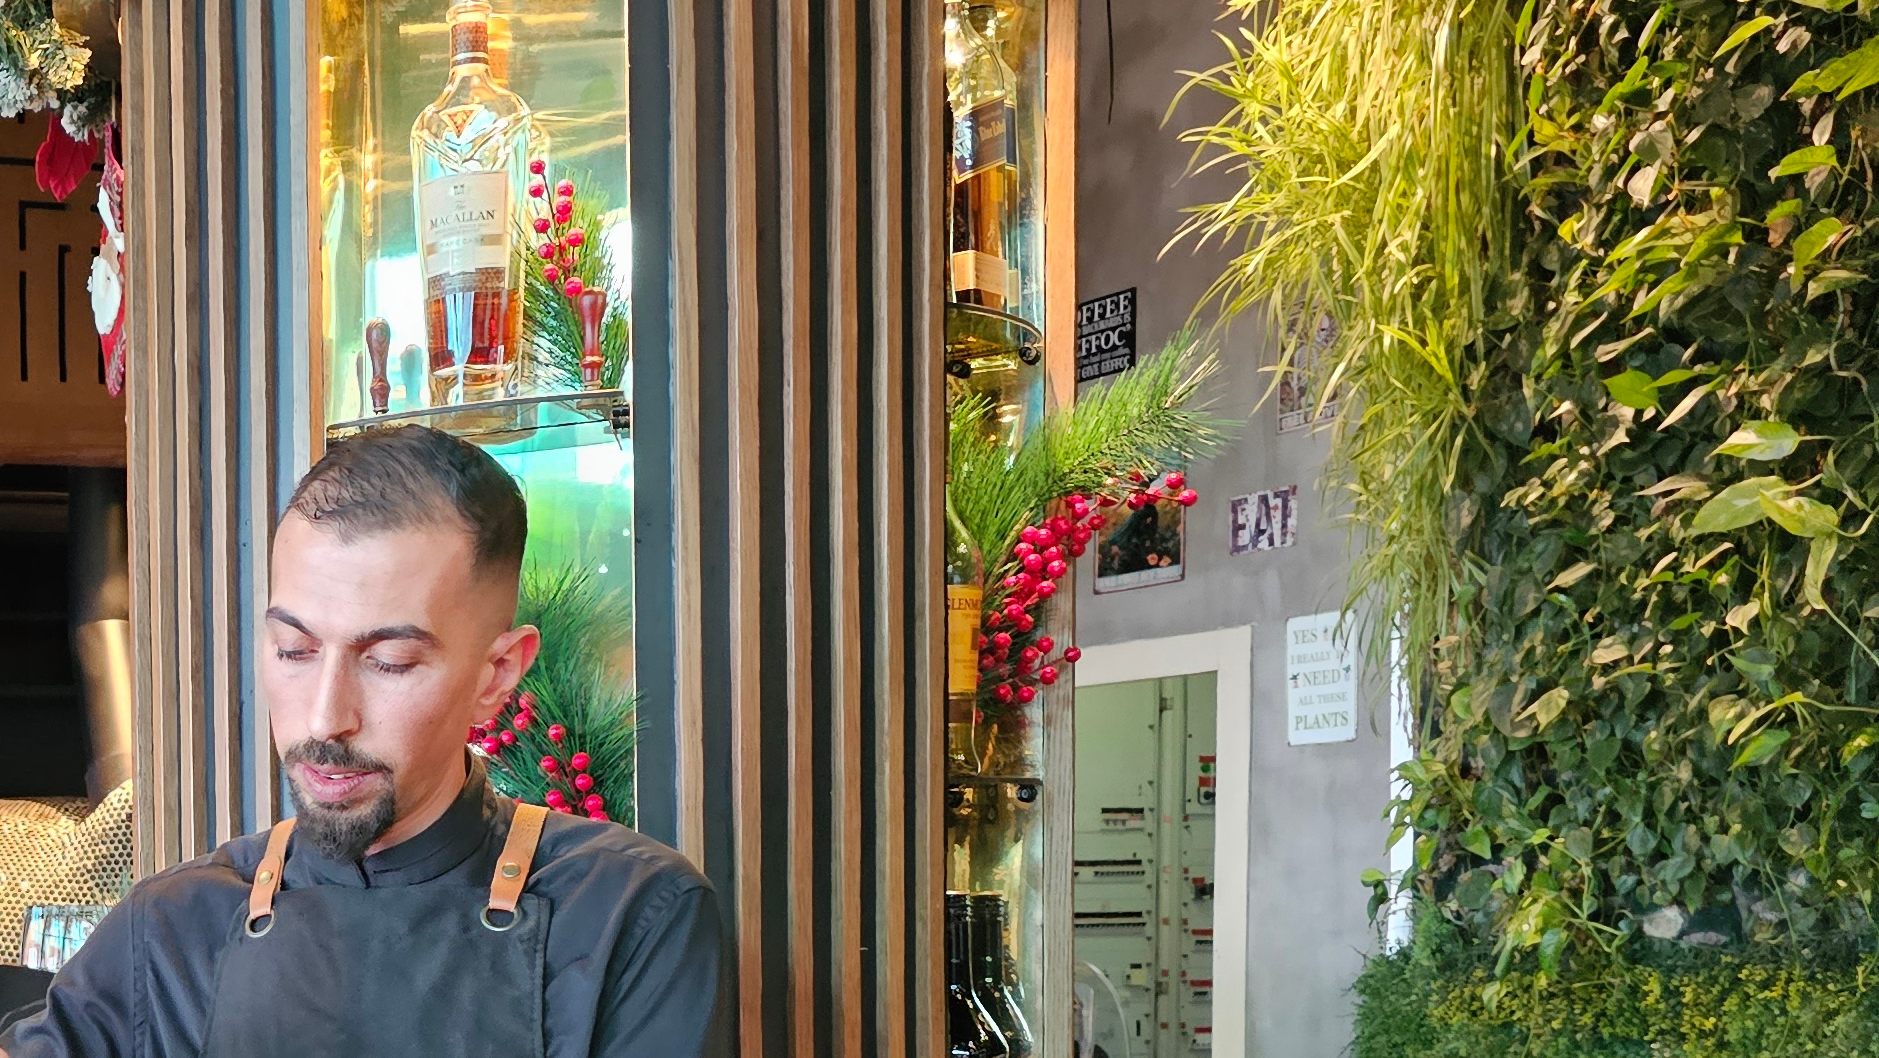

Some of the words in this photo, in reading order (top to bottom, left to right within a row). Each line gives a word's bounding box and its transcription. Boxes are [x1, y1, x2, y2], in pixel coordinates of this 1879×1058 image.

[430, 209, 496, 231] MACALLAN
[1231, 487, 1297, 554] EAT
[1293, 628, 1318, 646] YES
[1296, 651, 1331, 664] REALLY
[1302, 668, 1340, 687] NEED
[1297, 695, 1315, 707] ALL
[1316, 691, 1349, 705] THESE
[1294, 710, 1350, 731] PLANTS
